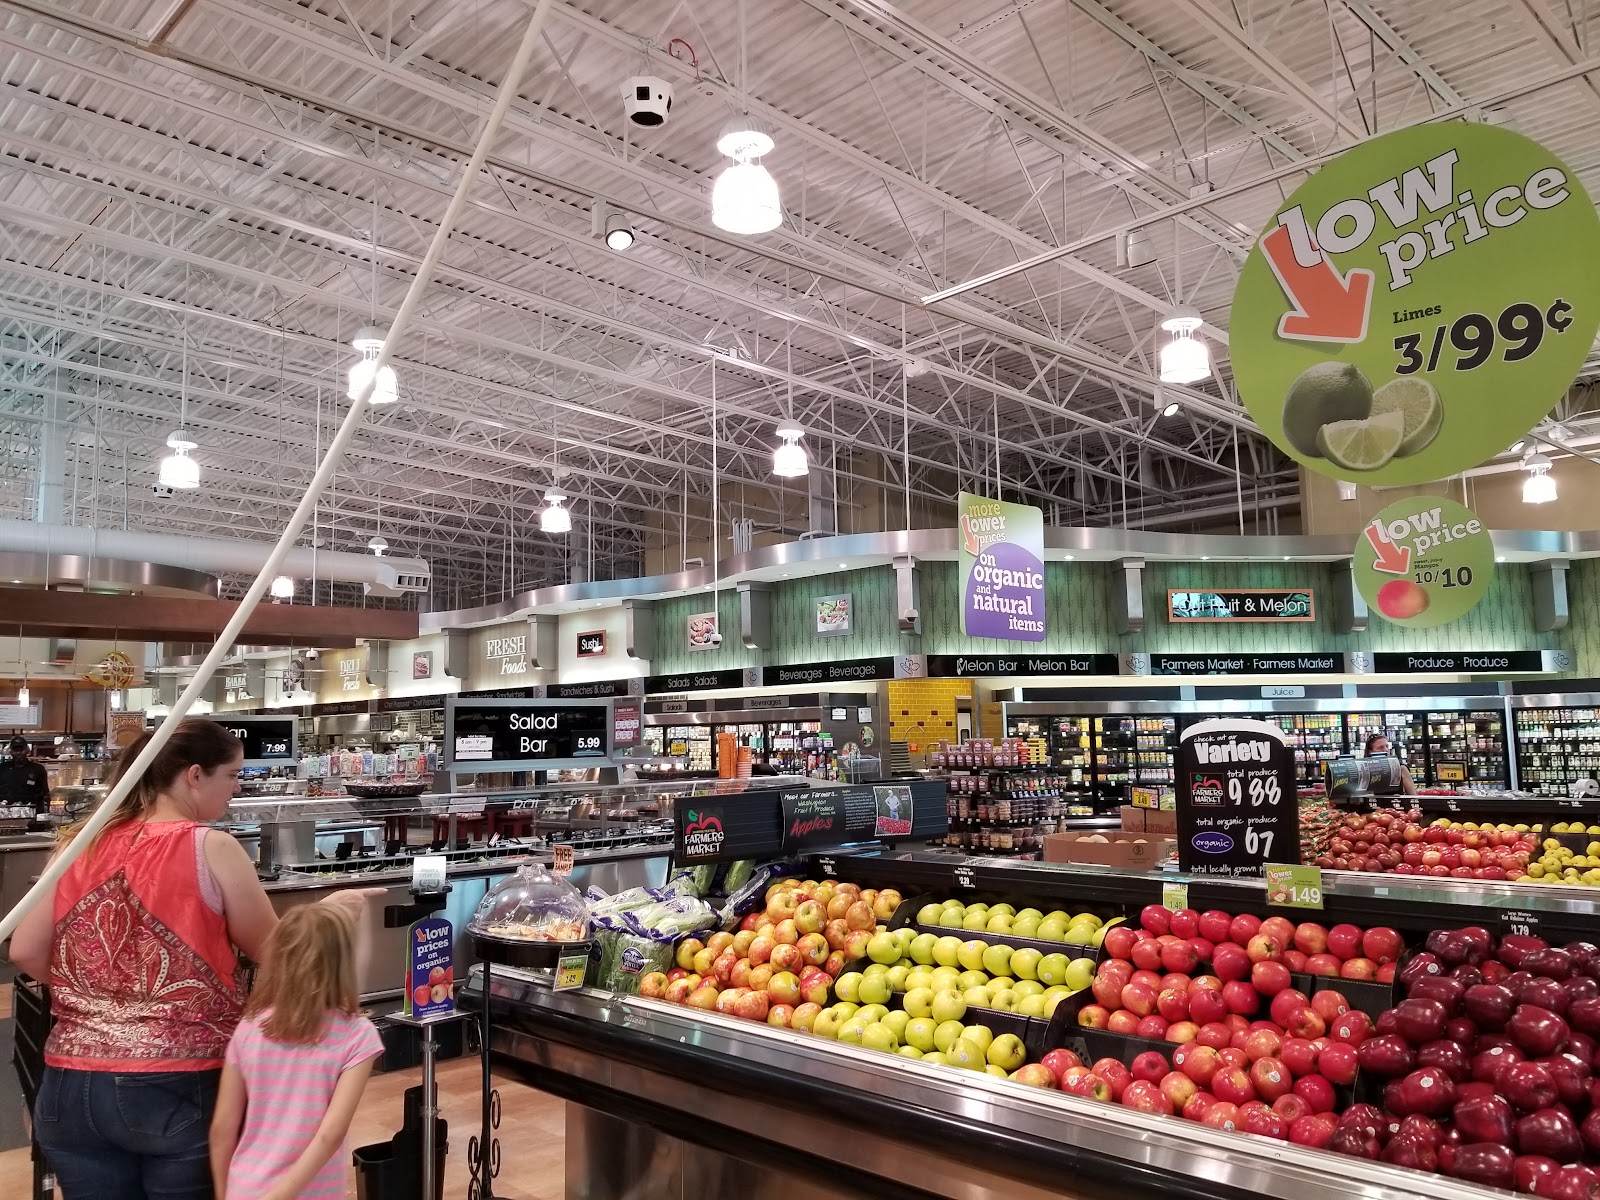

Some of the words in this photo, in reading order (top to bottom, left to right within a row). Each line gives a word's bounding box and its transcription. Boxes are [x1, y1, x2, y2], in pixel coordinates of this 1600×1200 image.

[1277, 148, 1460, 268] low
[1379, 166, 1572, 292] price
[1392, 304, 1443, 324] Limes
[968, 502, 1001, 517] more
[966, 514, 1006, 534] lower
[1372, 507, 1442, 544] low
[979, 531, 1006, 547] prices
[1412, 518, 1482, 557] price
[979, 552, 996, 567] on
[973, 567, 1043, 590] organic
[1415, 566, 1473, 588] 10/10
[976, 584, 991, 595] and
[973, 593, 1033, 616] natural
[1178, 598, 1206, 613] Cut
[1210, 598, 1240, 613] Fruit
[1244, 598, 1257, 613] &
[1260, 598, 1307, 613] Melon
[1008, 615, 1044, 632] items
[486, 635, 527, 657] FRESH
[581, 637, 600, 651] Sushi
[500, 655, 527, 675] Foods
[957, 659, 995, 673] Melon
[998, 659, 1018, 671] Bar
[1028, 659, 1067, 672] Melon
[1071, 659, 1090, 671] Bar
[1161, 658, 1205, 670] Farmers
[1206, 658, 1244, 670] Market
[1253, 658, 1296, 669] Farmers
[1298, 657, 1334, 669] Market
[1408, 656, 1454, 669] Produce
[1463, 656, 1509, 668] Produce
[779, 668, 823, 682] Beverages
[829, 663, 876, 678] Beverages
[667, 677, 690, 688] Salads
[694, 675, 718, 686] Salads
[560, 686, 594, 697] Sandwiches
[600, 683, 615, 694] Sushi
[1271, 687, 1295, 696] Juice
[666, 702, 684, 711] Salads
[750, 698, 782, 707] Beverages
[509, 713, 558, 730] Salad
[520, 736, 548, 753] Bar
[577, 737, 601, 748] 5.99
[1193, 735, 1216, 743] check
[265, 743, 287, 753] 7.99
[1194, 740, 1271, 765] Variety
[1227, 769, 1245, 778] total
[1248, 768, 1279, 777] produce
[784, 793, 799, 801] Meet
[1192, 789, 1224, 798] FARMERS
[1194, 796, 1222, 804] MARKET
[789, 815, 833, 837] Apples
[1196, 816, 1214, 827] total
[1216, 815, 1244, 830] organic
[1247, 815, 1279, 826] produce
[684, 831, 725, 845] FARMERS
[1195, 839, 1230, 849] organic
[1245, 826, 1275, 858] 67
[555, 847, 572, 861] FREE
[686, 842, 721, 856] MARKET
[554, 862, 572, 871] SAMPLE
[1190, 864, 1207, 874] total
[1209, 863, 1231, 877] locally
[1234, 865, 1257, 877] grown
[1289, 886, 1321, 904] 1.49
[1169, 900, 1183, 910] 1.49
[425, 925, 449, 941] low
[416, 939, 449, 958] prices
[428, 950, 438, 960] on
[416, 956, 450, 971] organics
